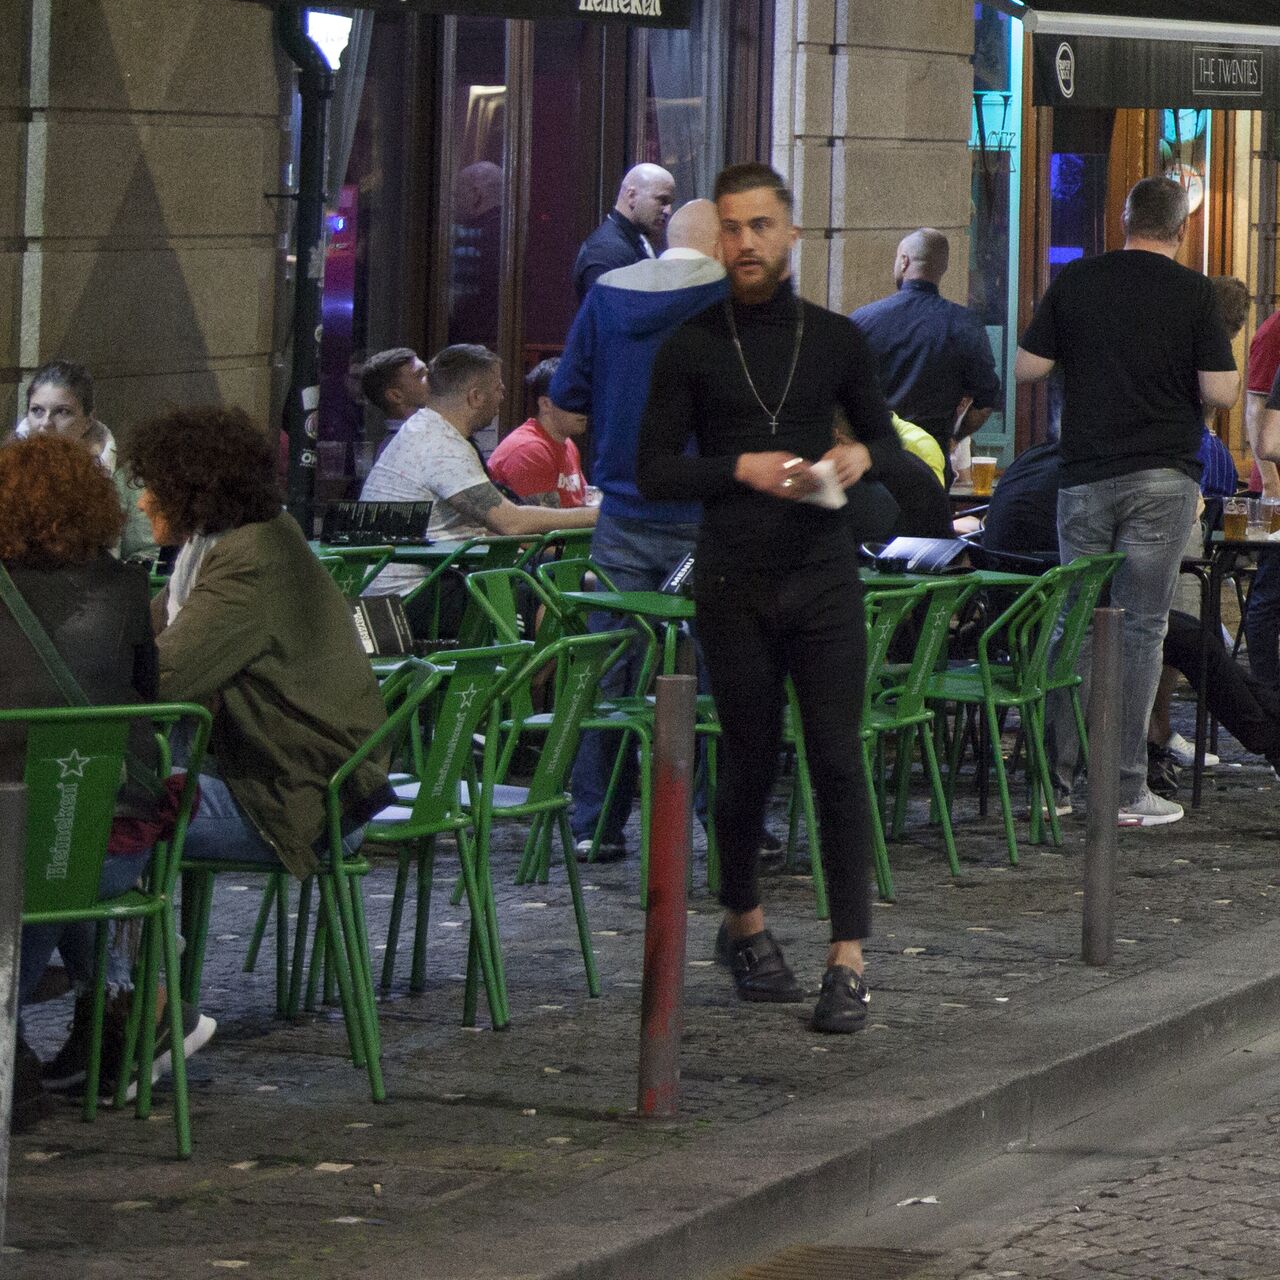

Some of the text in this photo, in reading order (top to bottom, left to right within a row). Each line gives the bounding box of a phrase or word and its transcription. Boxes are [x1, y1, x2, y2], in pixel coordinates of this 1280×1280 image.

[1199, 57, 1259, 86] THE TWENTIES
[46, 782, 79, 881] Heineken
